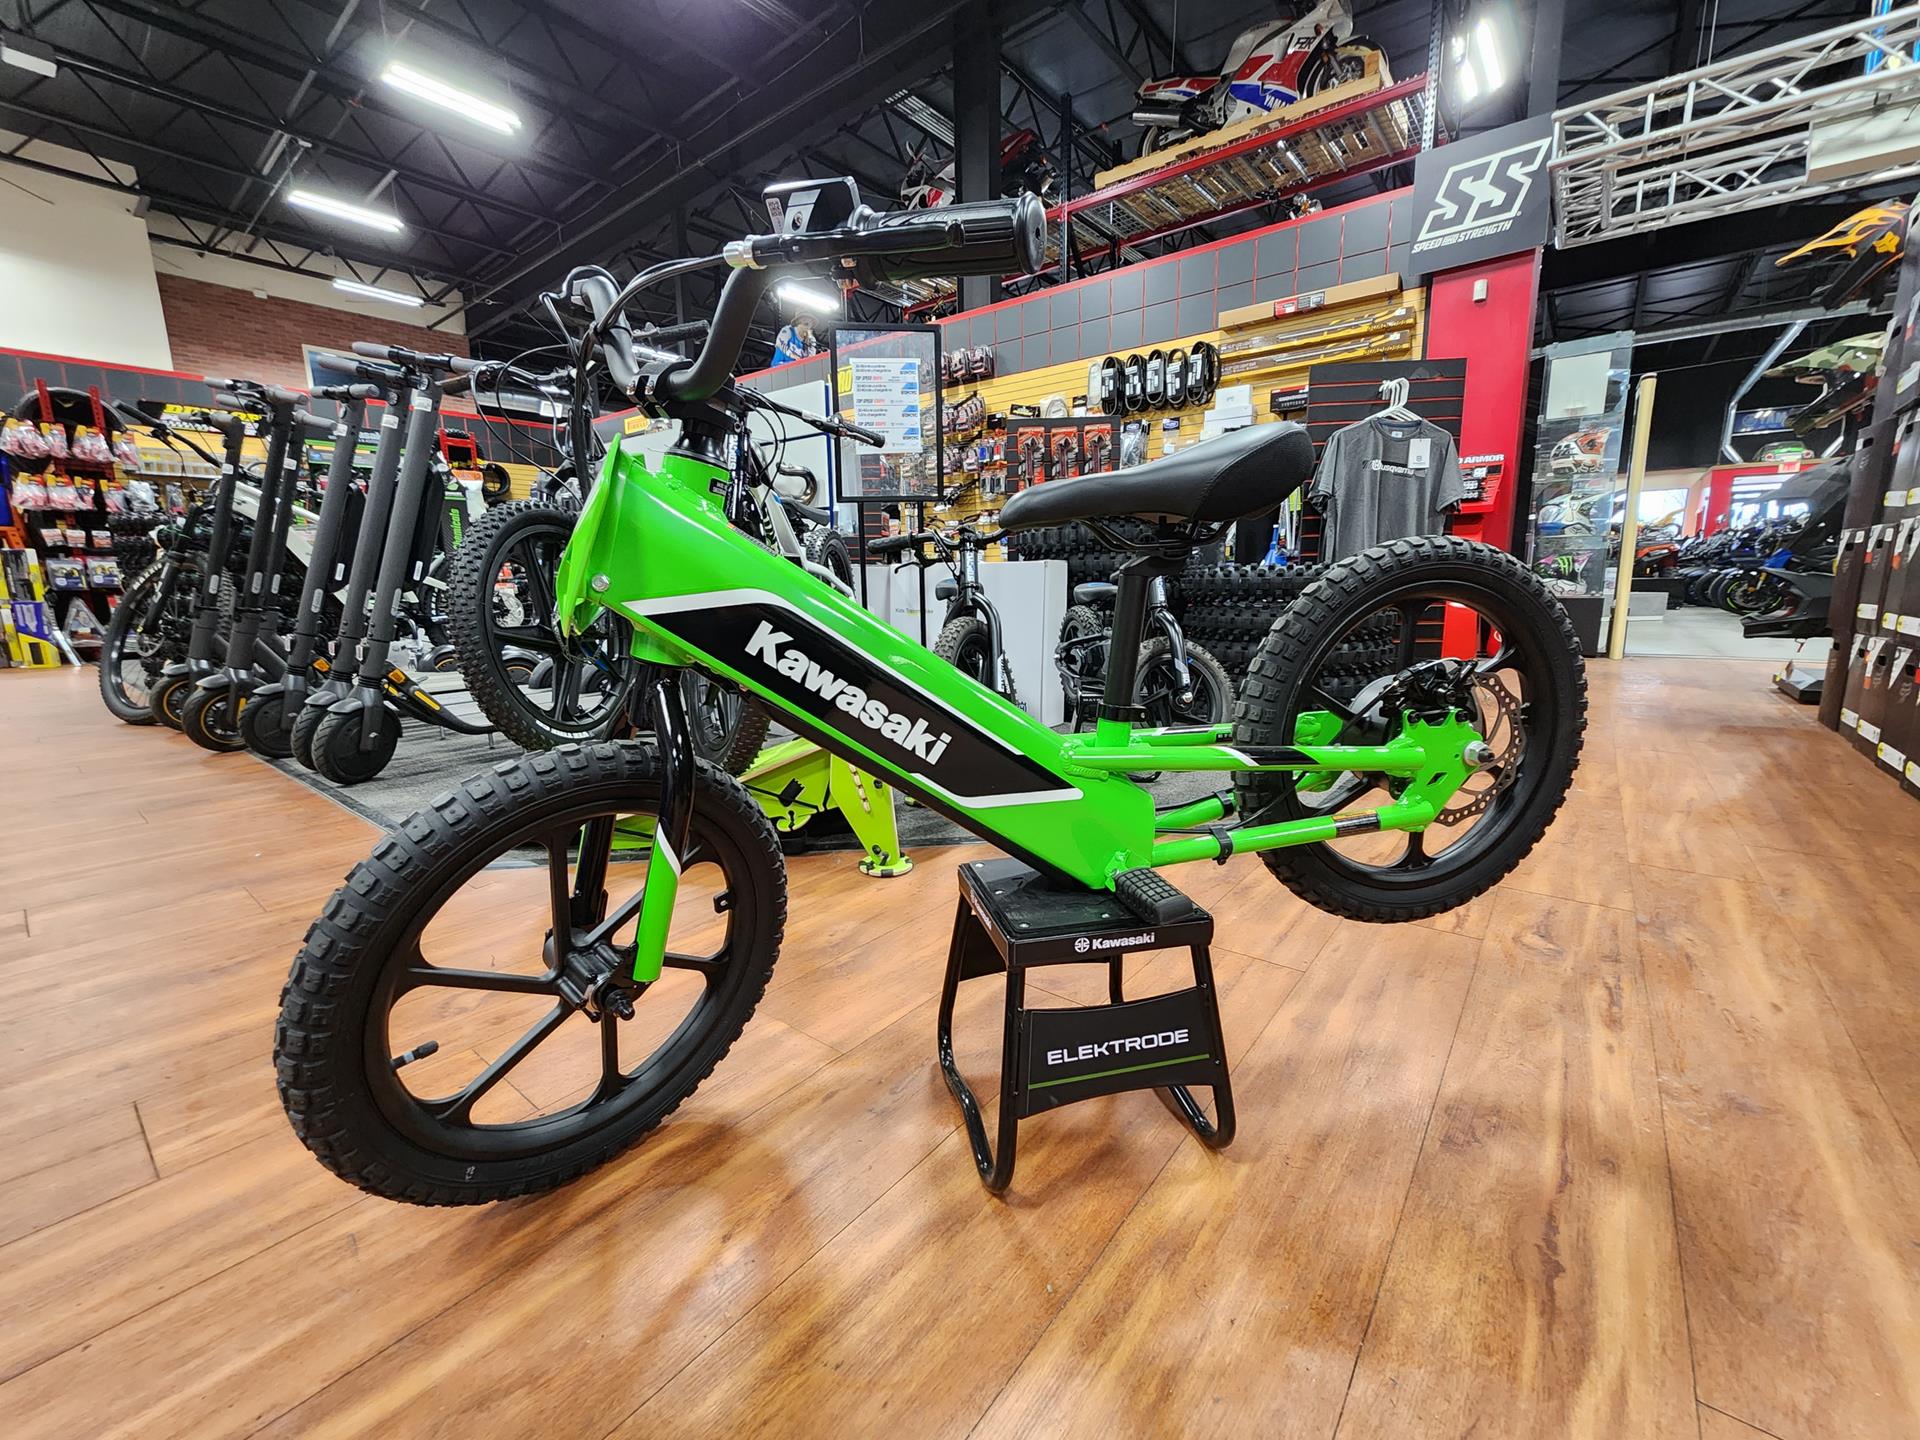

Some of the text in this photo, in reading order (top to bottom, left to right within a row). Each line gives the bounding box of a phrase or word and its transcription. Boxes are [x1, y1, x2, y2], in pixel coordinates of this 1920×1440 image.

[1294, 36, 1317, 50] FZR
[1416, 136, 1552, 241] SS
[1411, 237, 1442, 254] SPEED
[1457, 219, 1513, 242] STRENGTH
[1464, 454, 1505, 463] ARMOR
[132, 562, 162, 591] MAXXIS
[744, 619, 953, 766] Kawasaki
[1092, 932, 1155, 950] Kawasaki
[1046, 1028, 1190, 1066] ELEKTRODE
